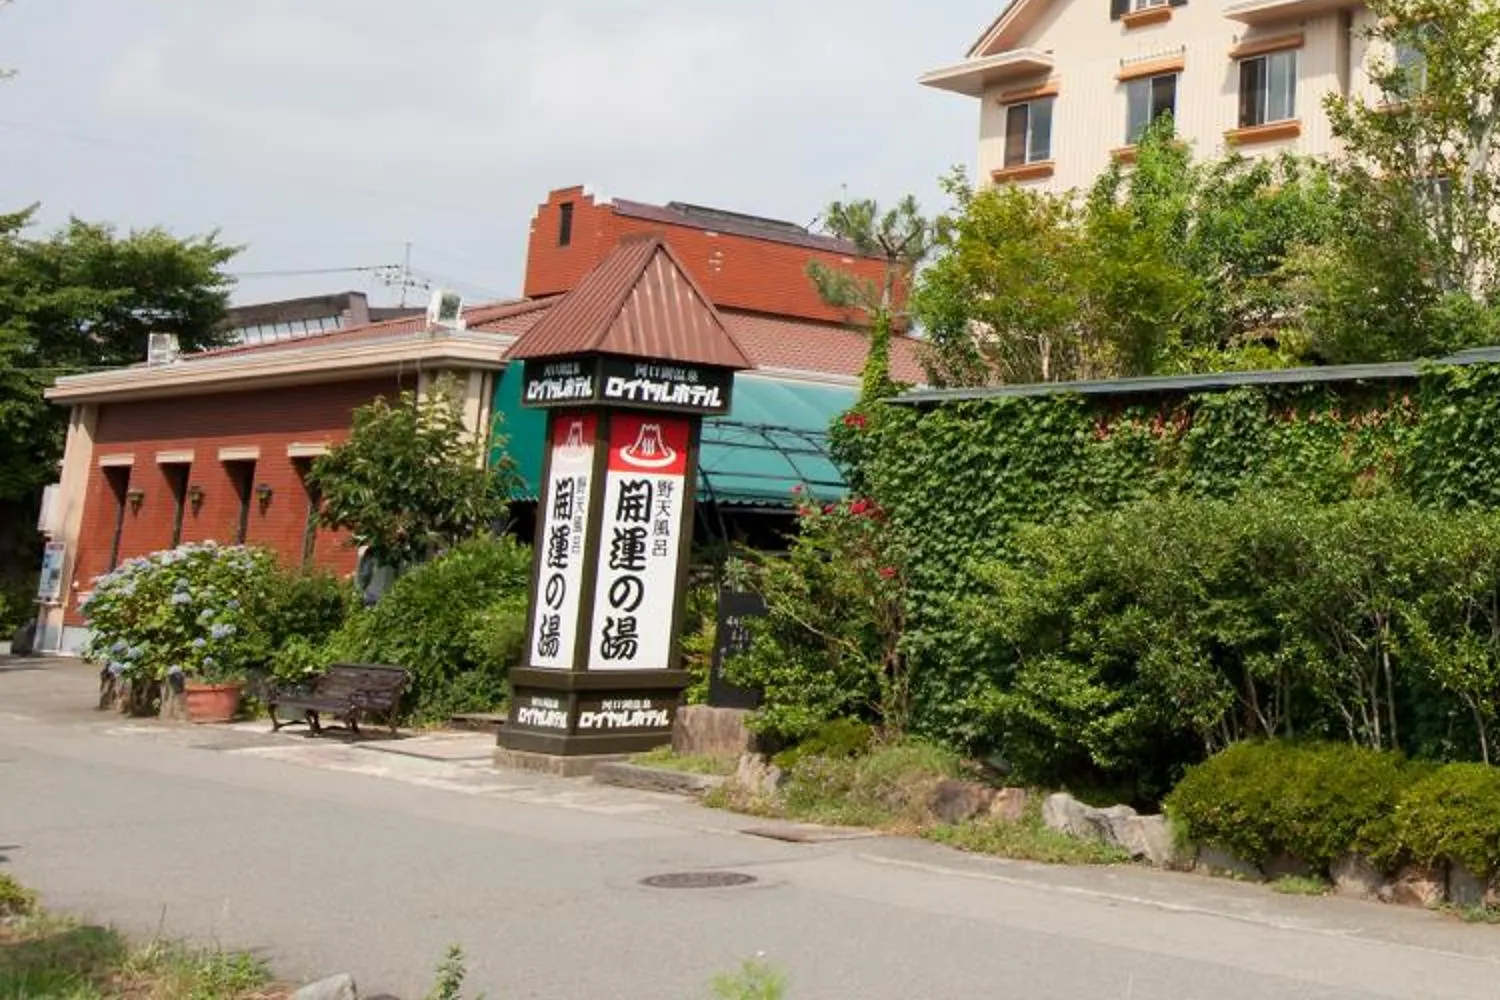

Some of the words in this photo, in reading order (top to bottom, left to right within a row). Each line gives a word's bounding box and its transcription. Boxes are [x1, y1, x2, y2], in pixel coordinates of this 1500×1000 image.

[605, 376, 722, 407] ロイヤルホテル
[652, 479, 675, 557] 野天風呂
[537, 475, 575, 658] 開運の湯
[601, 479, 653, 661] 開運の湯
[578, 709, 670, 729] ロイヤルホテル
